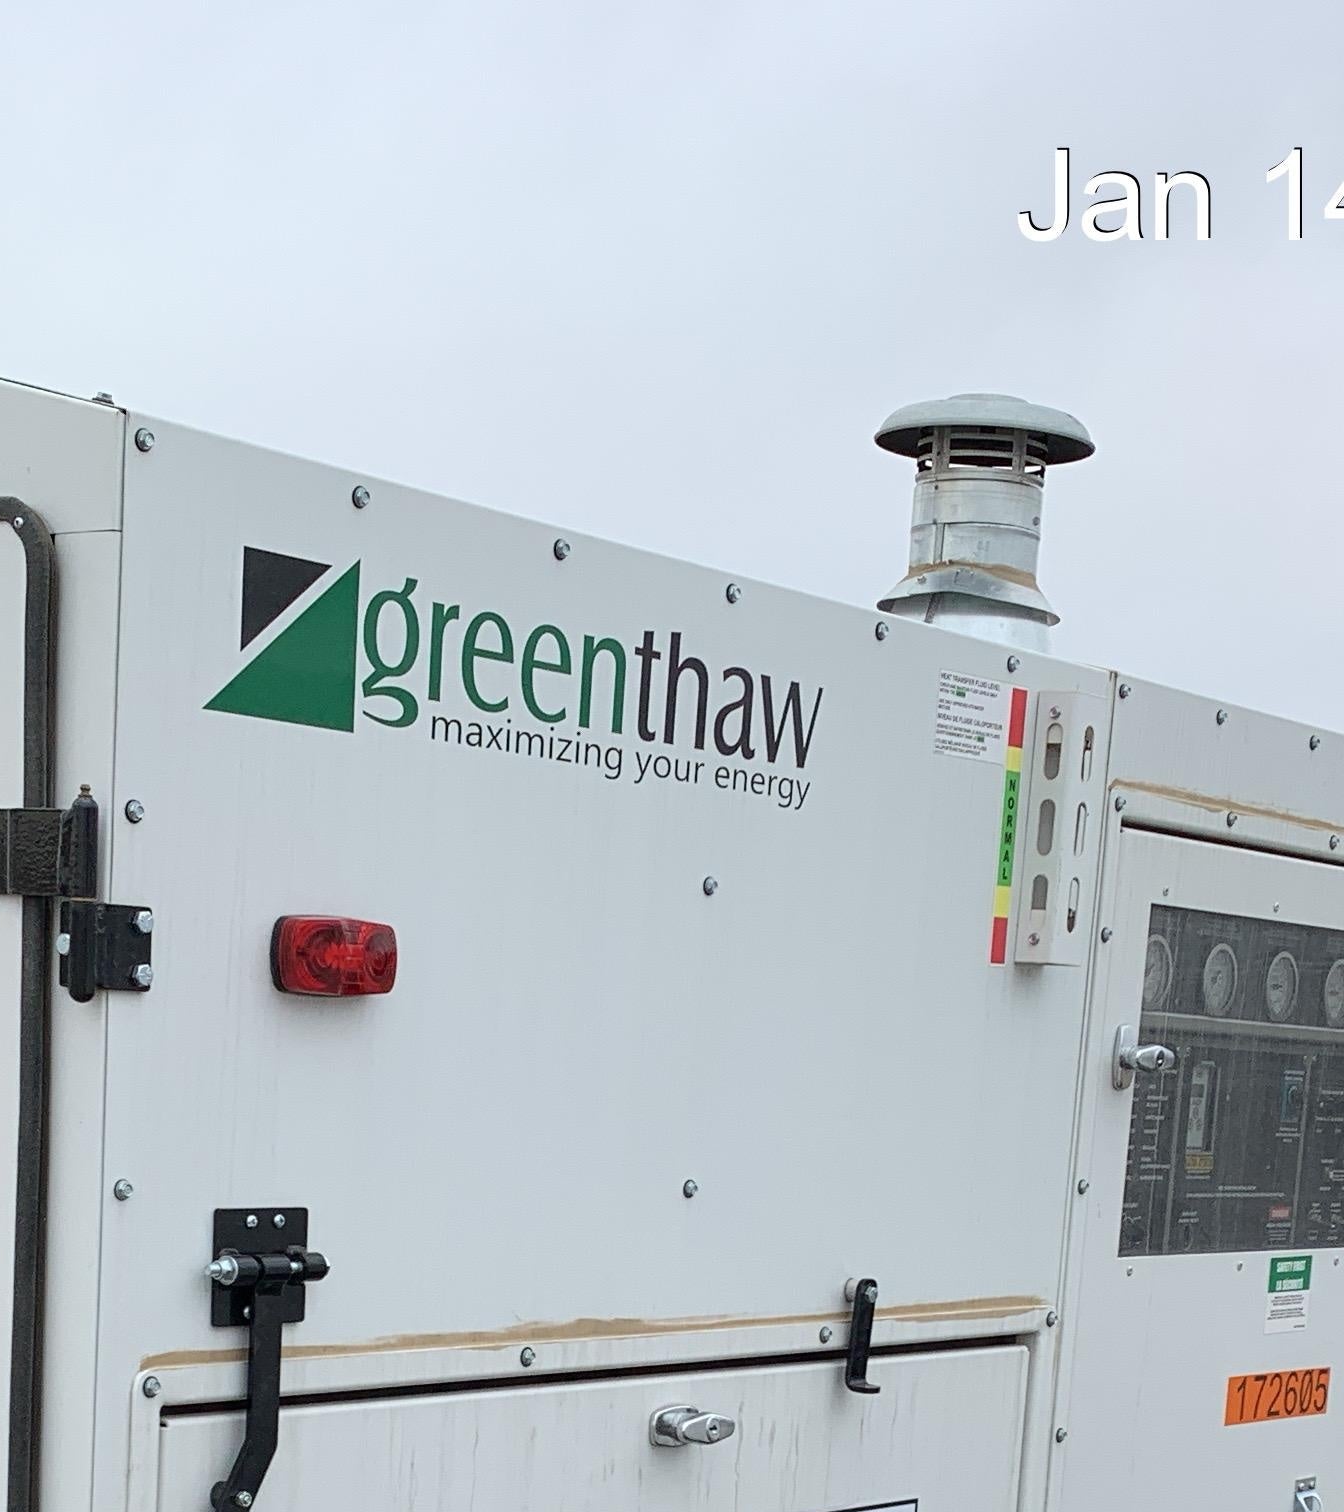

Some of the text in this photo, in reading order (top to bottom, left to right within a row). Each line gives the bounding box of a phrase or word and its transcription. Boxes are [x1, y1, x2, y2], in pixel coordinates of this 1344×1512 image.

[362, 577, 824, 769] greenthaw
[431, 710, 811, 811] maximizing your energy
[1001, 778, 1017, 881] NORMAL
[1237, 1368, 1329, 1422] 172605
